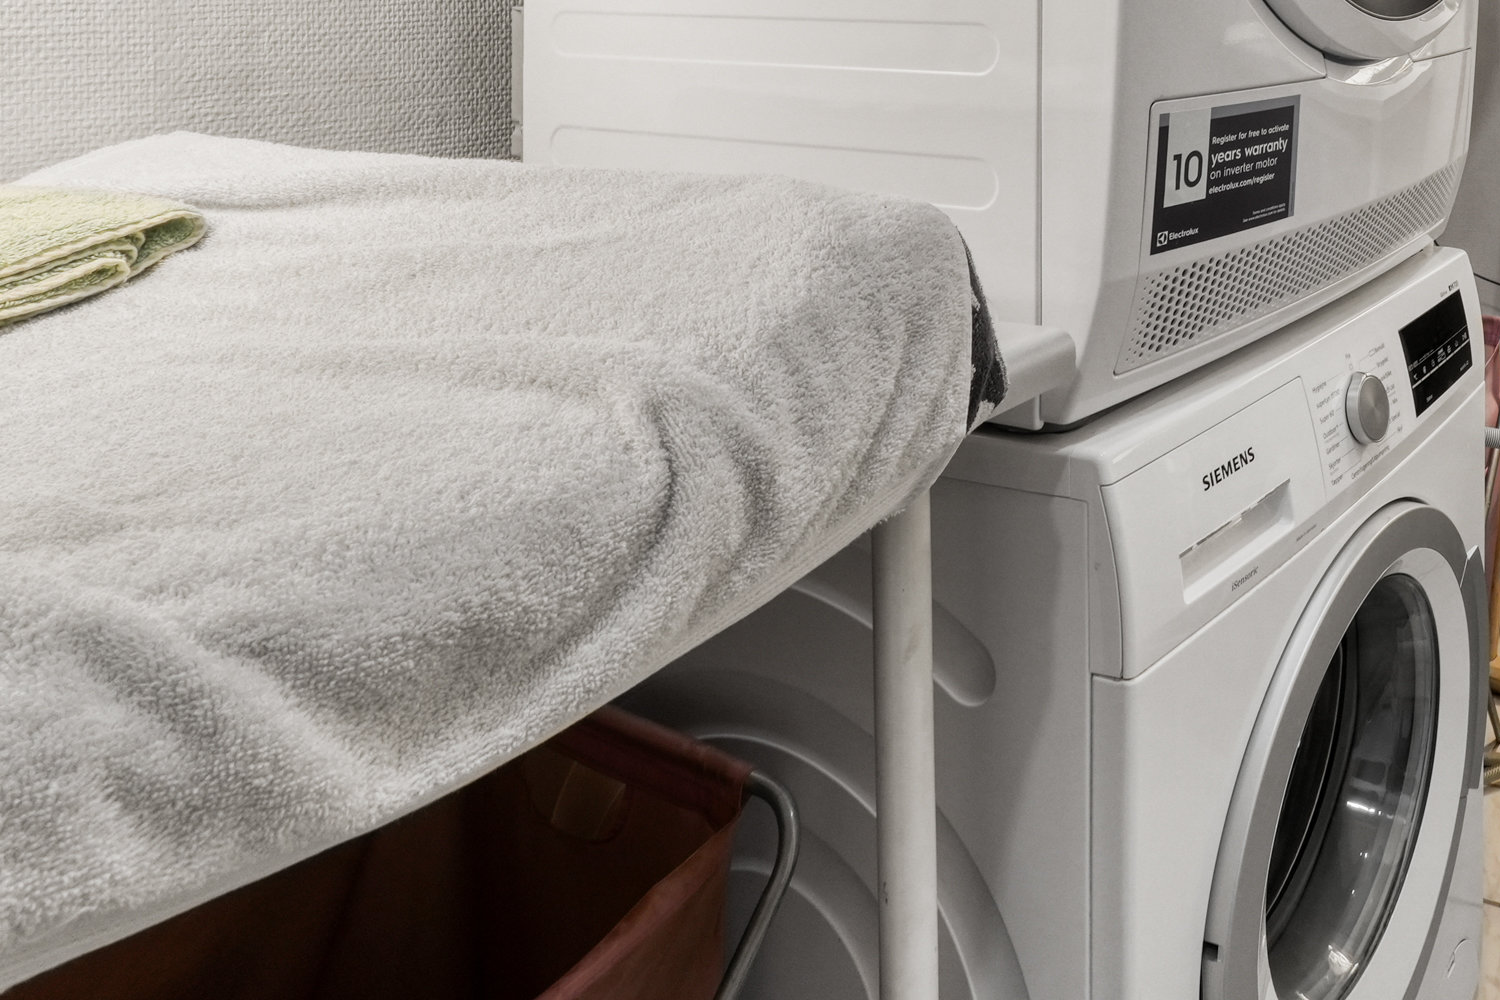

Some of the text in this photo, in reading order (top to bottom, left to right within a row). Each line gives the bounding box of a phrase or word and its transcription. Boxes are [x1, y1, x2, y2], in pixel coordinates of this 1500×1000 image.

[1212, 134, 1237, 146] Register
[1239, 131, 1247, 140] for
[1248, 129, 1260, 138] free
[1268, 123, 1289, 135] activate
[1211, 137, 1288, 168] years warranty
[1173, 150, 1204, 191] 10
[1210, 157, 1278, 180] on inverter motor
[1208, 172, 1275, 194] electrolux.com/register
[1168, 227, 1199, 240] Electrolux
[1202, 446, 1255, 492] SIEMENS
